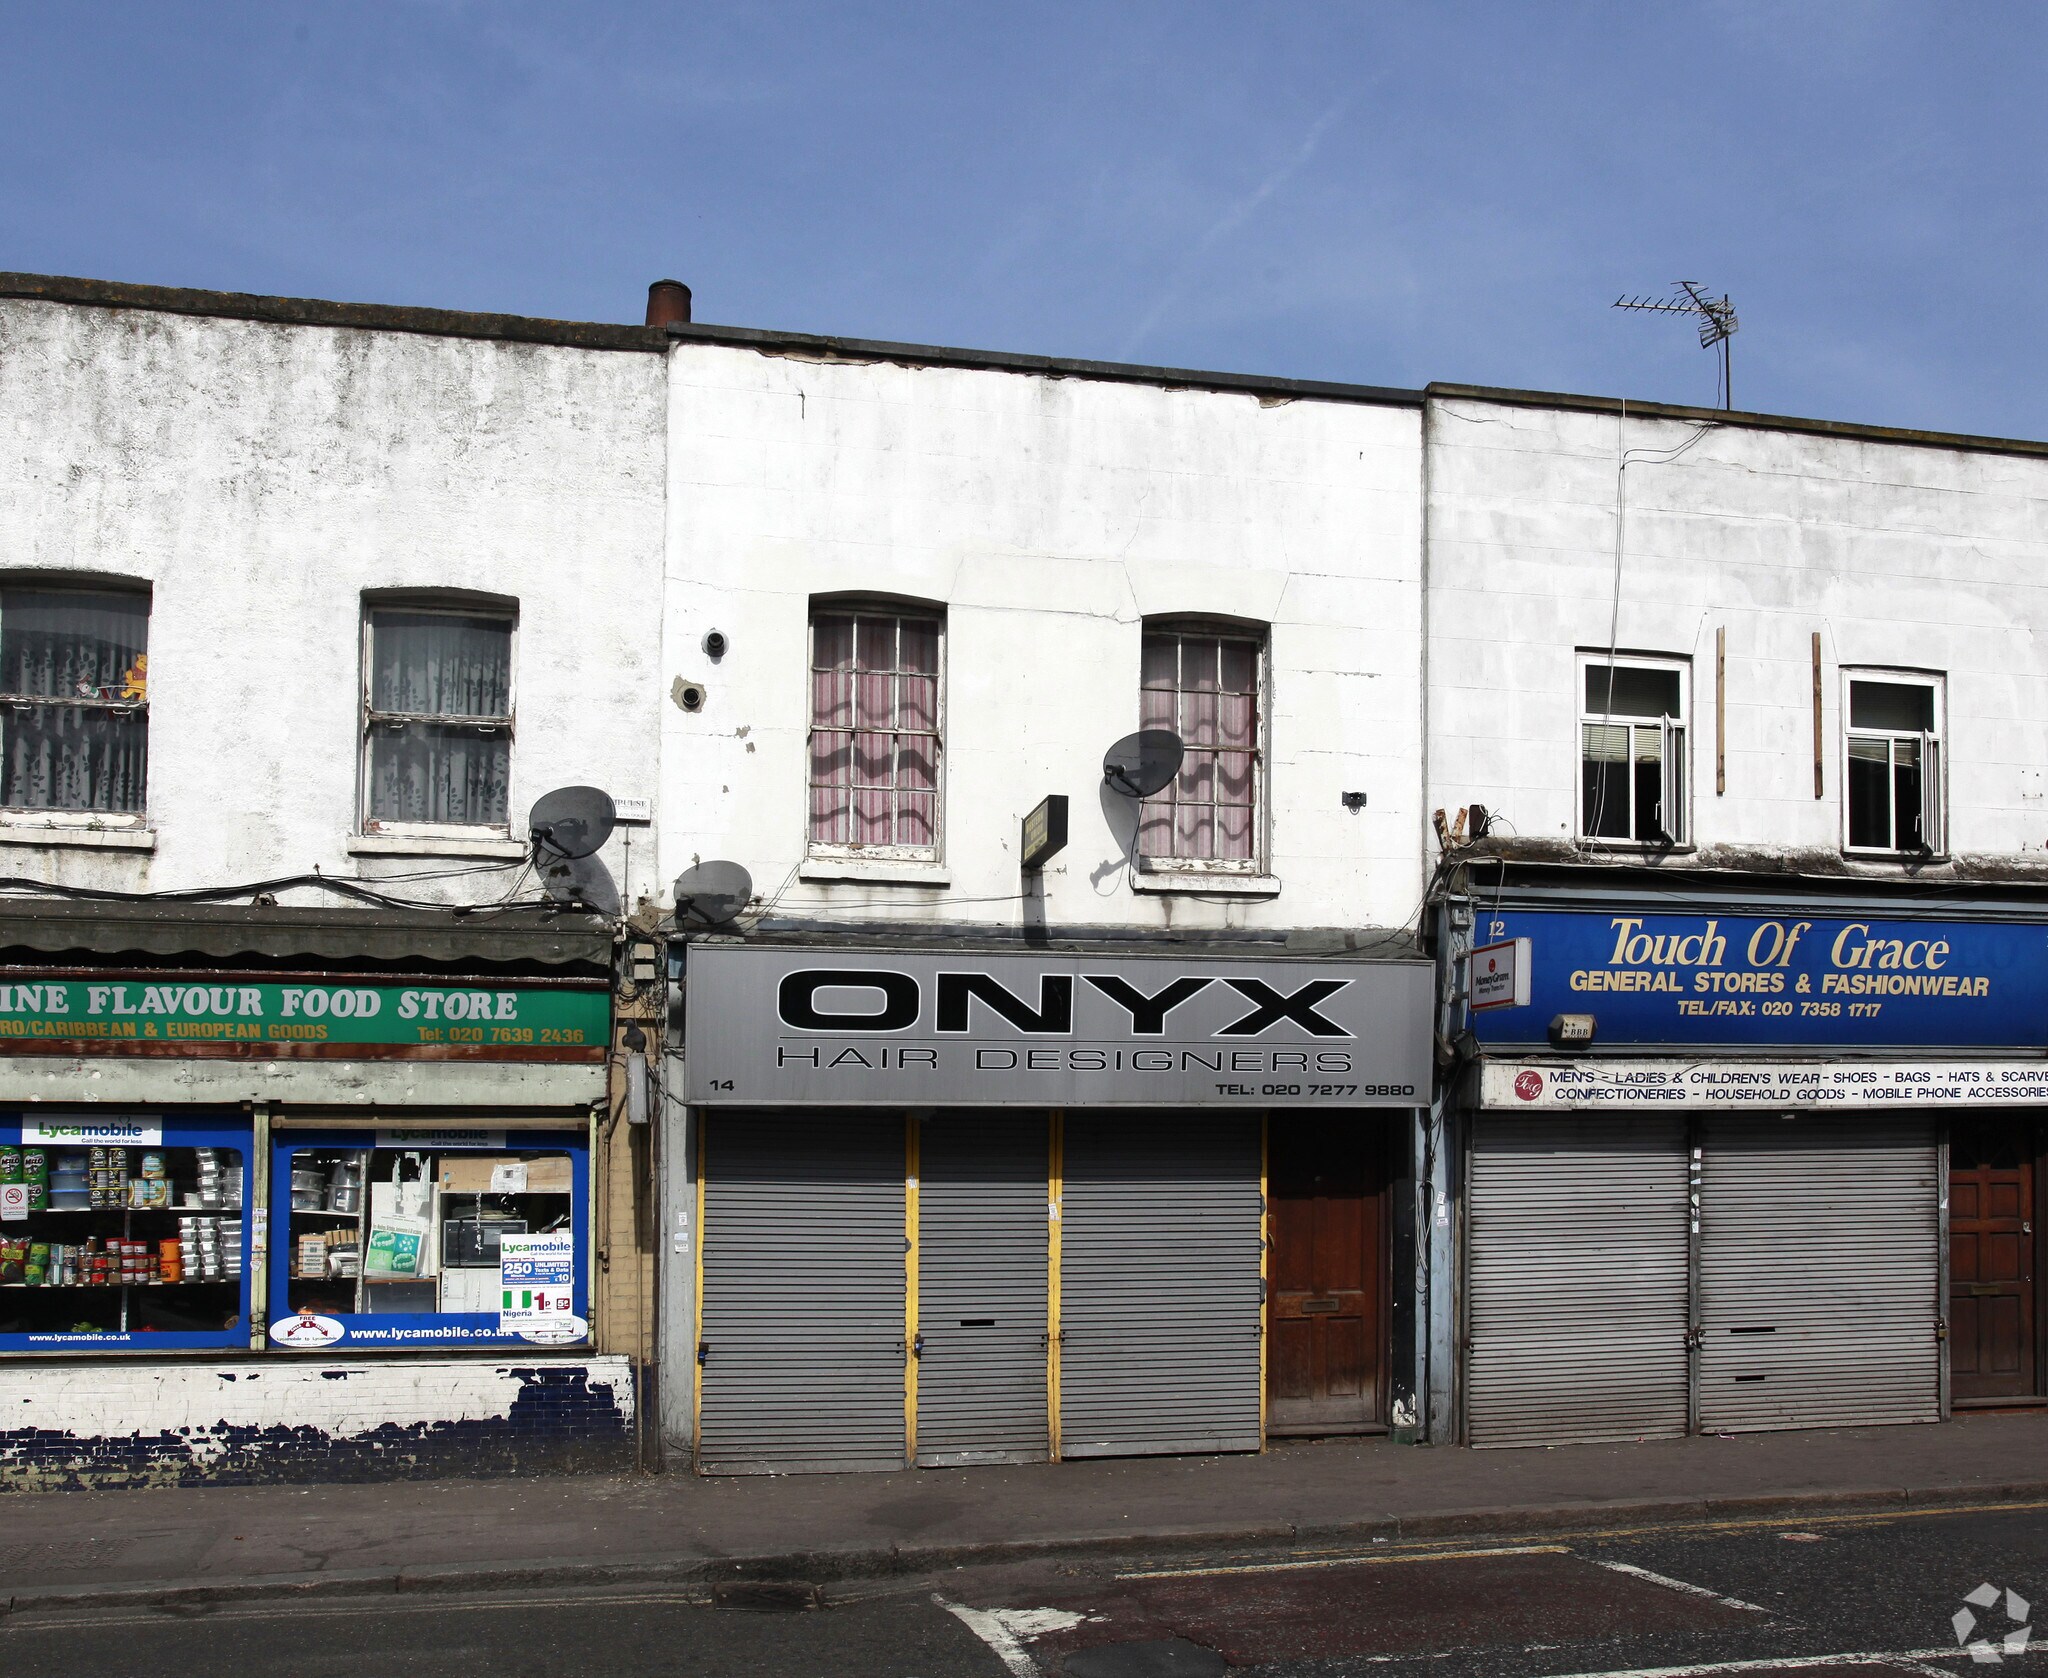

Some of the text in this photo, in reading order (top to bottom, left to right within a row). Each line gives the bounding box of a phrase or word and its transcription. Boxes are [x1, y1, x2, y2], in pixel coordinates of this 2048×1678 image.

[1488, 921, 1505, 936] 12
[1608, 918, 1727, 966] Touch
[1747, 921, 1812, 967] Of
[1831, 923, 1950, 970] Grace
[1569, 970, 1990, 997] GENERAL STORES & FASHIONWEAR
[0, 984, 518, 1021] INE FLAVOUR FOOD STORE
[776, 968, 1358, 1038] ONYX
[1678, 1000, 1882, 1017] TEL/FAX: 020 7358 1717
[0, 1019, 328, 1039] RO/CARIBBEAN & EUROPEAN GOODS
[417, 1026, 585, 1043] Tel: 020 7639 2436
[776, 1046, 1353, 1073] HAIR DESIGNERS
[1550, 1071, 1595, 1083] MEN'S
[1615, 1072, 1667, 1084] LADIES
[1672, 1072, 1683, 1084] &
[1690, 1072, 1771, 1084] CHILDREN'S
[1778, 1073, 1821, 1084] WEAR
[1833, 1071, 1878, 1083] SHOES
[1895, 1071, 1931, 1083] BAGS
[1948, 1071, 1980, 1082] HATS
[1985, 1071, 1995, 1082] &
[709, 1080, 735, 1091] 14
[1215, 1084, 1415, 1097] TEL: 020 7277 9880
[1554, 1088, 1686, 1100] CONFECTIONERIES
[1705, 1088, 1791, 1100] HOUSEHOLD
[1796, 1088, 1846, 1100] GOODS
[1863, 1087, 1912, 1099] MOBILE
[1917, 1087, 1961, 1098] PHONE
[1967, 1087, 2048, 1098] ACCESSORIE
[38, 1122, 143, 1138] Lycamobile
[502, 1242, 571, 1253] Lycamobile
[503, 1262, 532, 1274] 250
[503, 1310, 532, 1318] Nigeria
[29, 1333, 131, 1342] www.lycamobile.co.uk
